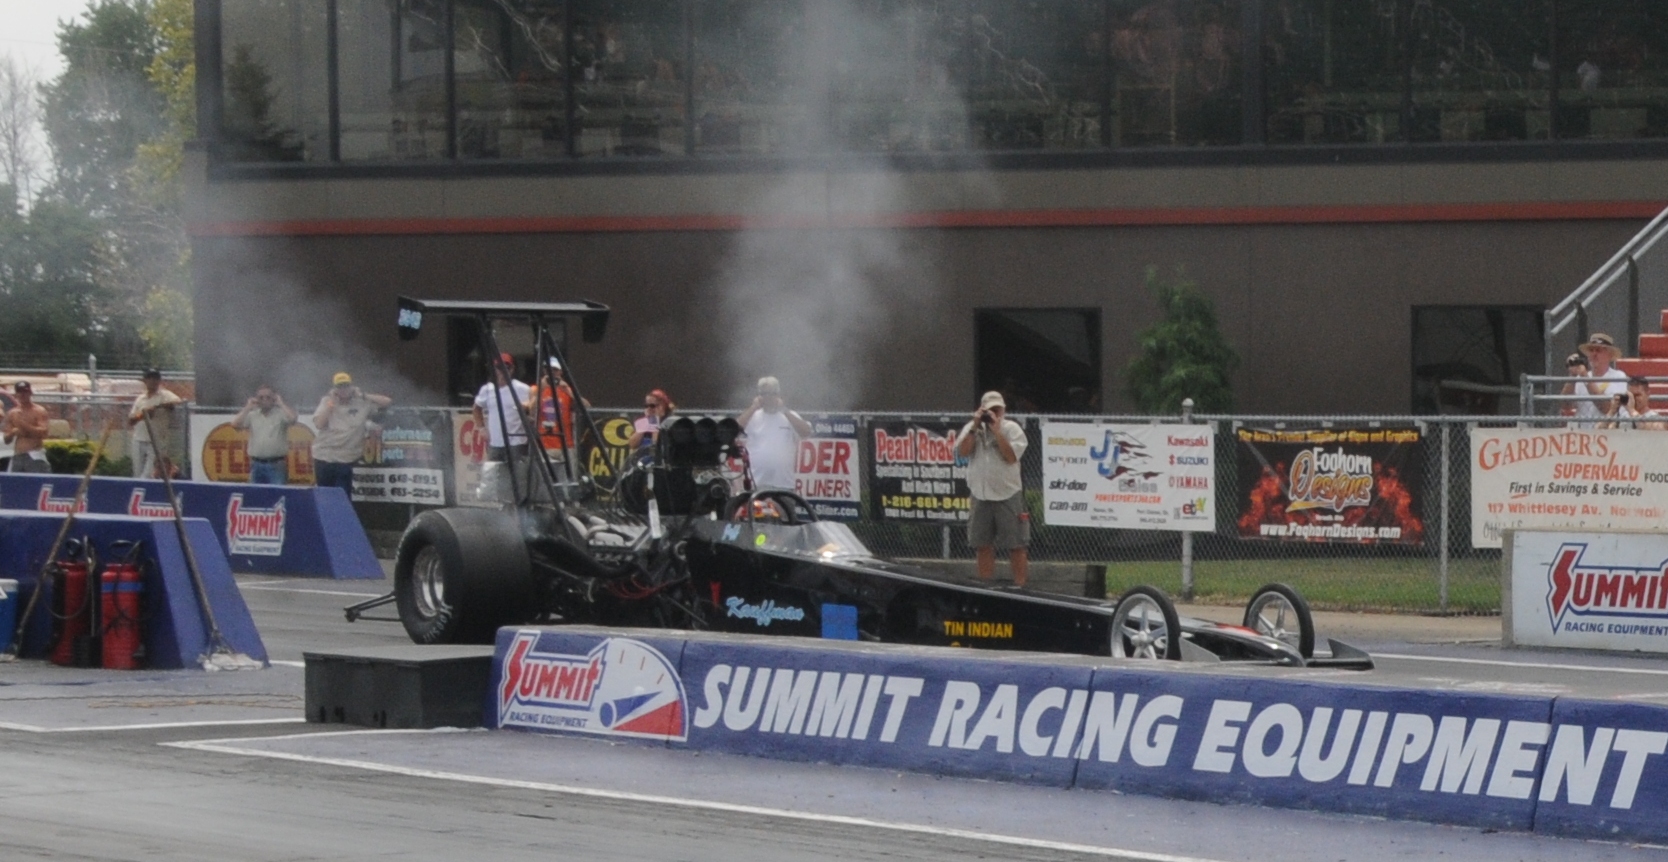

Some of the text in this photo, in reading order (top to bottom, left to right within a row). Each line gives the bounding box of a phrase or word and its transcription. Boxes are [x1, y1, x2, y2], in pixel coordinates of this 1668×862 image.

[875, 429, 915, 462] Pearl
[917, 430, 956, 464] Road
[1167, 435, 1208, 447] Kawasaki
[1313, 447, 1372, 475] Foghorn
[1478, 432, 1608, 471] GARDNER'S
[1177, 457, 1209, 466] SUZUKI
[1553, 452, 1640, 482] SUPERVALU
[806, 479, 851, 498] LINERS
[1049, 479, 1087, 491] ski-doo
[1177, 476, 1209, 489] YAMAHA
[1289, 450, 1374, 513] Designs
[1509, 480, 1643, 497] First in Savings & Service
[1049, 501, 1088, 512] can-am
[1508, 502, 1577, 517] Whittlesey
[1581, 505, 1602, 516] Av.
[1610, 506, 1662, 518] Nowal
[230, 499, 283, 539] SUMMIT
[1260, 522, 1401, 541] www.FoghornDesigns.com
[1551, 550, 1668, 618] SUMMIT
[944, 621, 1013, 638] TIN INDIAN
[1564, 621, 1668, 639] RACING EQUIPMENT
[503, 640, 601, 706] SUMMIT
[509, 711, 589, 729] RACING EQUIPMENT
[694, 664, 1667, 810] SUMMIT RACING EQUIPMENT
